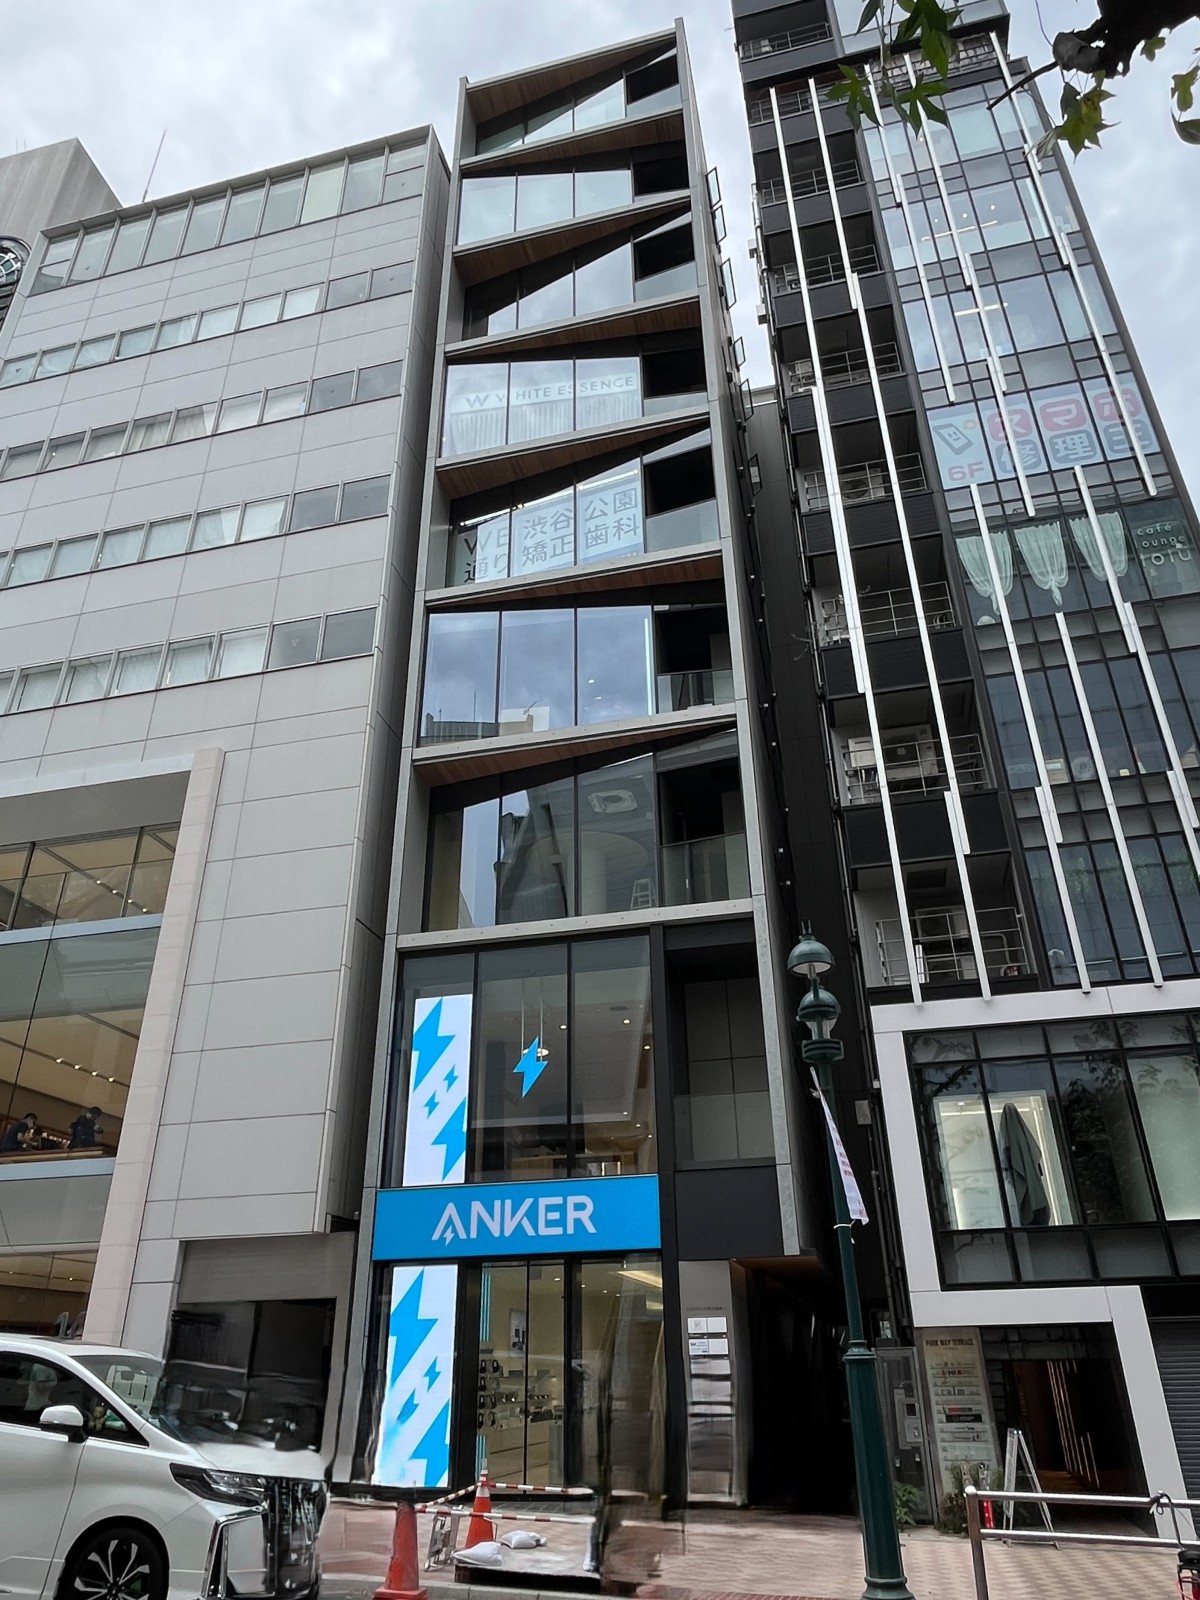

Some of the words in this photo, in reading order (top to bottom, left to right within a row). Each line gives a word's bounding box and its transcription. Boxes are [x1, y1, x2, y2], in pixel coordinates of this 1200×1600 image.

[558, 376, 634, 396] ESSENCE
[947, 461, 985, 481] 6F
[431, 1194, 597, 1245] ANKER
